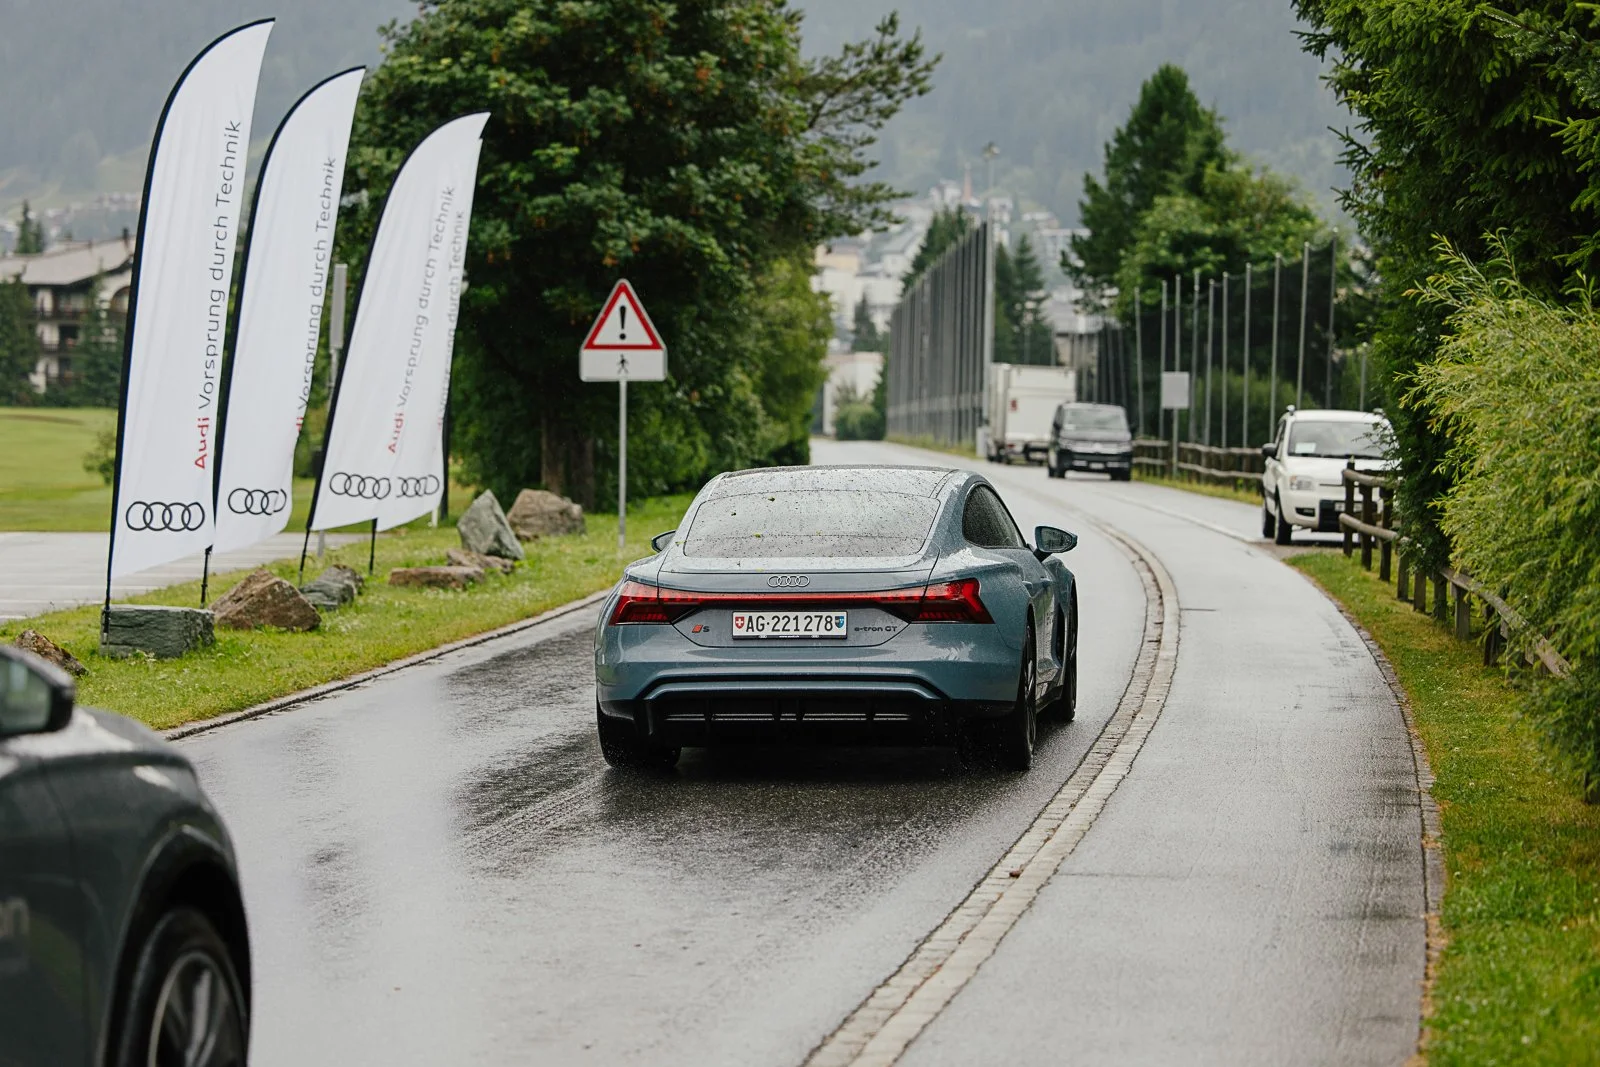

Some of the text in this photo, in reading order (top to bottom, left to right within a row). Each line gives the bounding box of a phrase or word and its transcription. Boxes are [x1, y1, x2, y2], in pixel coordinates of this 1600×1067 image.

[309, 240, 327, 297] durch
[315, 157, 336, 232] Technik
[194, 120, 241, 469] Audi Vorsprung durch Technik
[388, 186, 455, 453] Audi Vorsprung durch Technik
